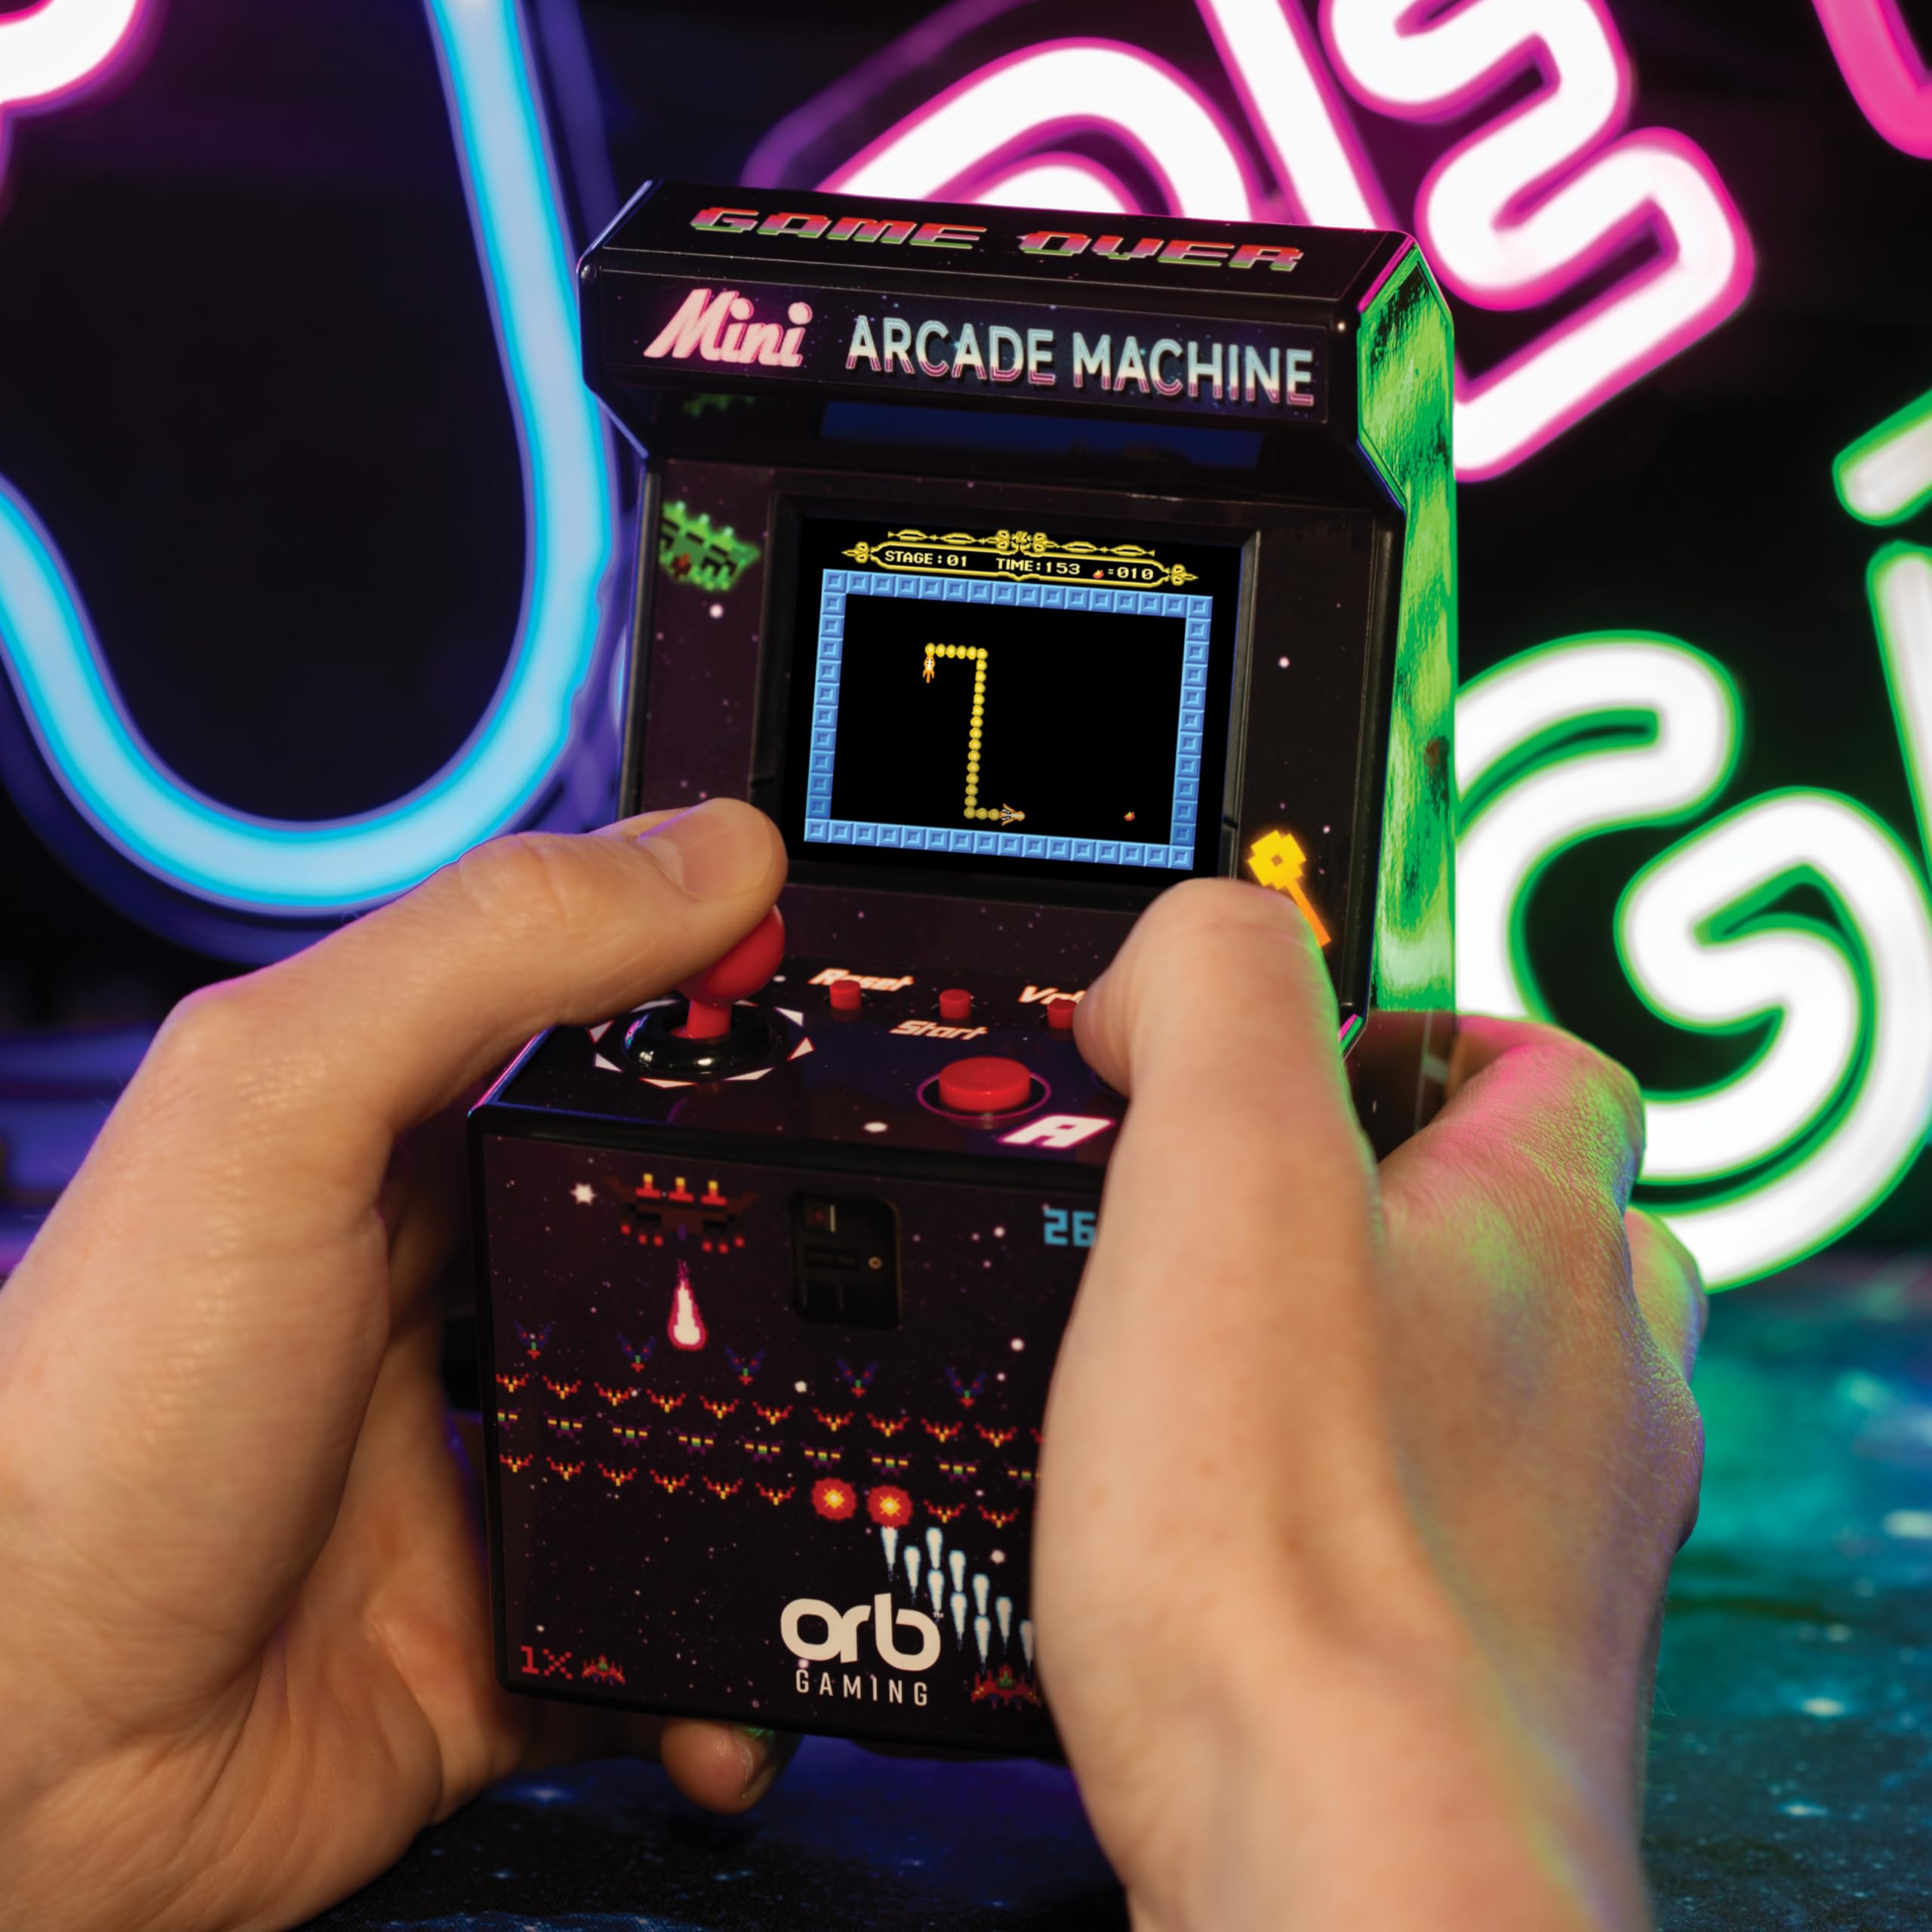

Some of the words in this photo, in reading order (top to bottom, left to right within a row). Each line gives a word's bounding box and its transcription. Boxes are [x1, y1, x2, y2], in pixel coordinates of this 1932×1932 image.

[690, 207, 986, 249] GAME
[1018, 230, 1304, 272] OVER
[643, 288, 813, 368] Mini
[845, 315, 1056, 385] ARCADE
[1072, 332, 1315, 406] MACHINE
[889, 1020, 987, 1040] Start
[997, 1115, 1115, 1149] A
[780, 1592, 941, 1672] orb
[795, 1669, 928, 1706] GAMING
